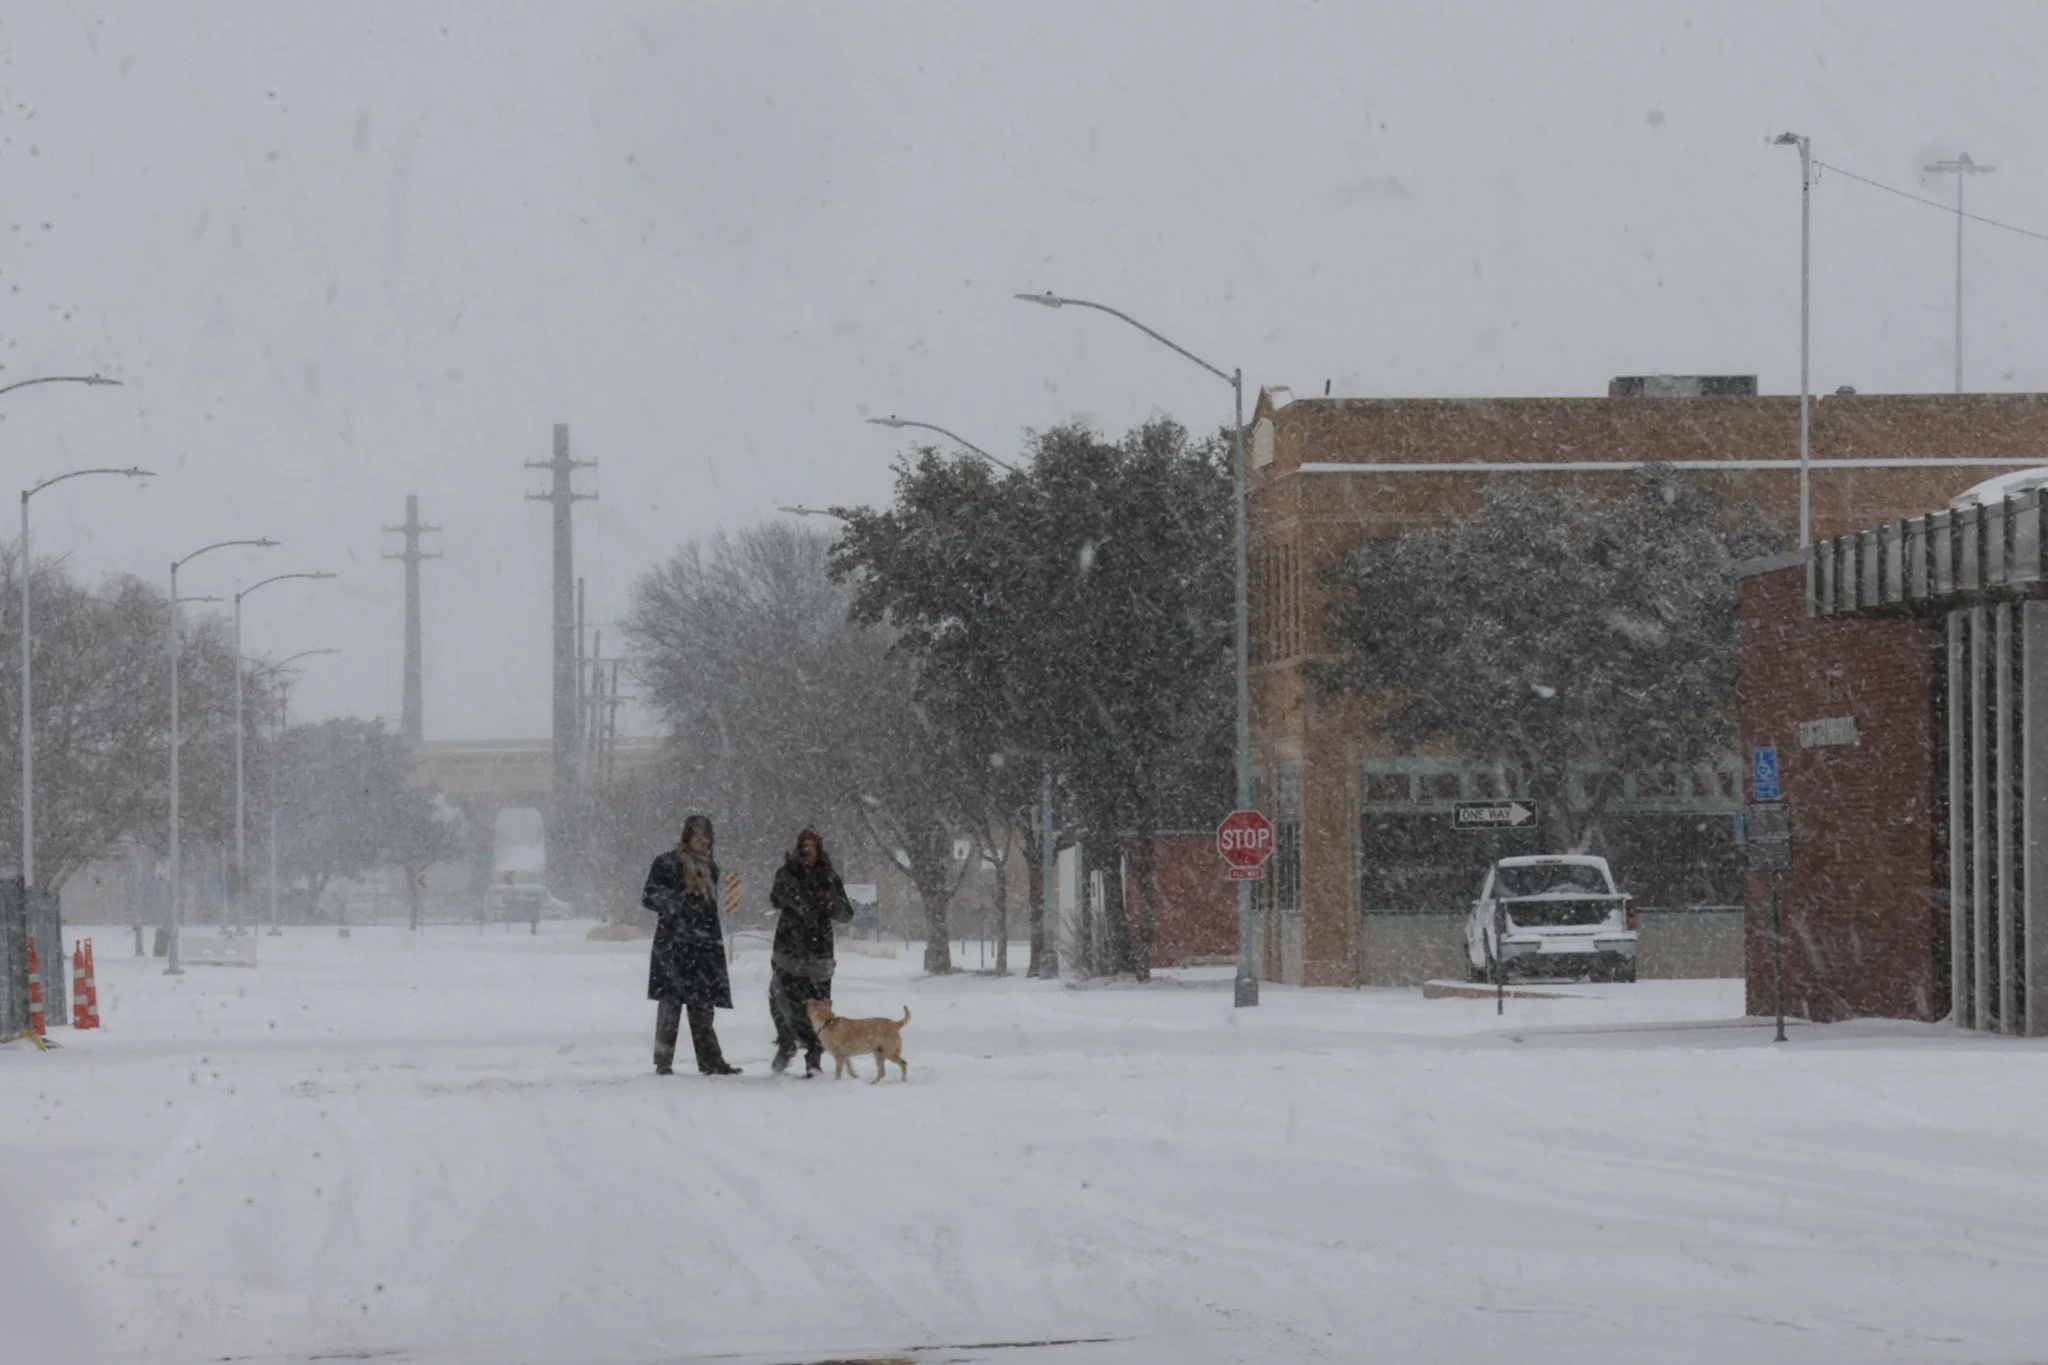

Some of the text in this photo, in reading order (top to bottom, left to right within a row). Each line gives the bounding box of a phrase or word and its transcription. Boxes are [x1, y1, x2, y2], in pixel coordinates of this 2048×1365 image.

[1463, 808, 1511, 820] ONE WAY
[1221, 828, 1269, 850] STOP
